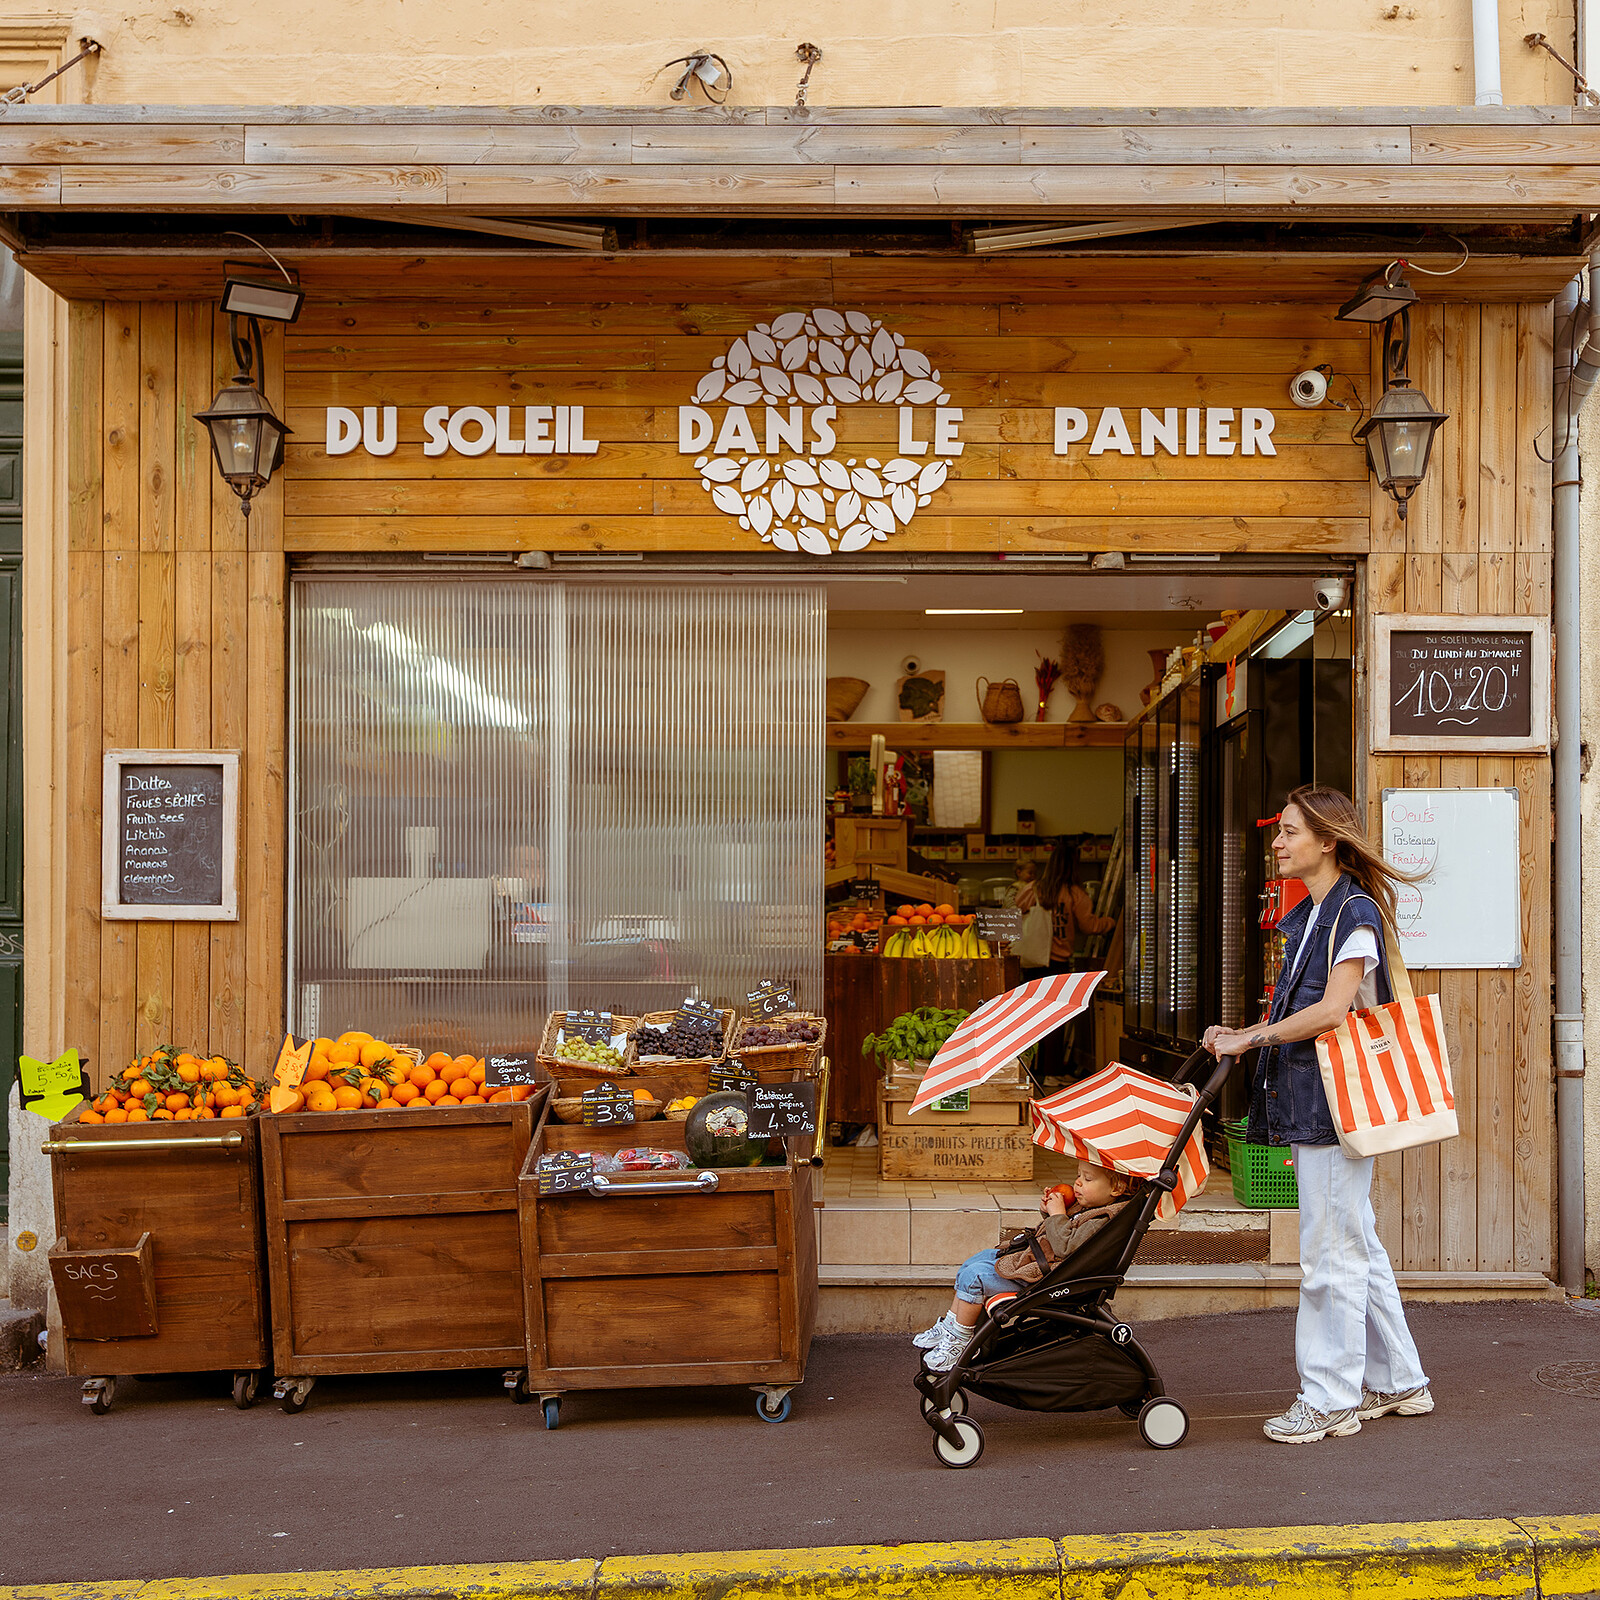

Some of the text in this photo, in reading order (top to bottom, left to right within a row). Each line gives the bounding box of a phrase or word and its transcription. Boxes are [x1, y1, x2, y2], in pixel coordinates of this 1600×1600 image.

[325, 405, 1277, 457] DU SOLEIL DANS LE PANIER
[1411, 648, 1428, 659] DU
[1464, 649, 1477, 658] AU
[125, 775, 172, 791] Dattes
[1396, 893, 1424, 903] aisins
[888, 1135, 909, 1149] LES
[914, 1136, 966, 1149] PRODUITS
[933, 1153, 985, 1167] ROMANS
[64, 1263, 119, 1280] SACS
